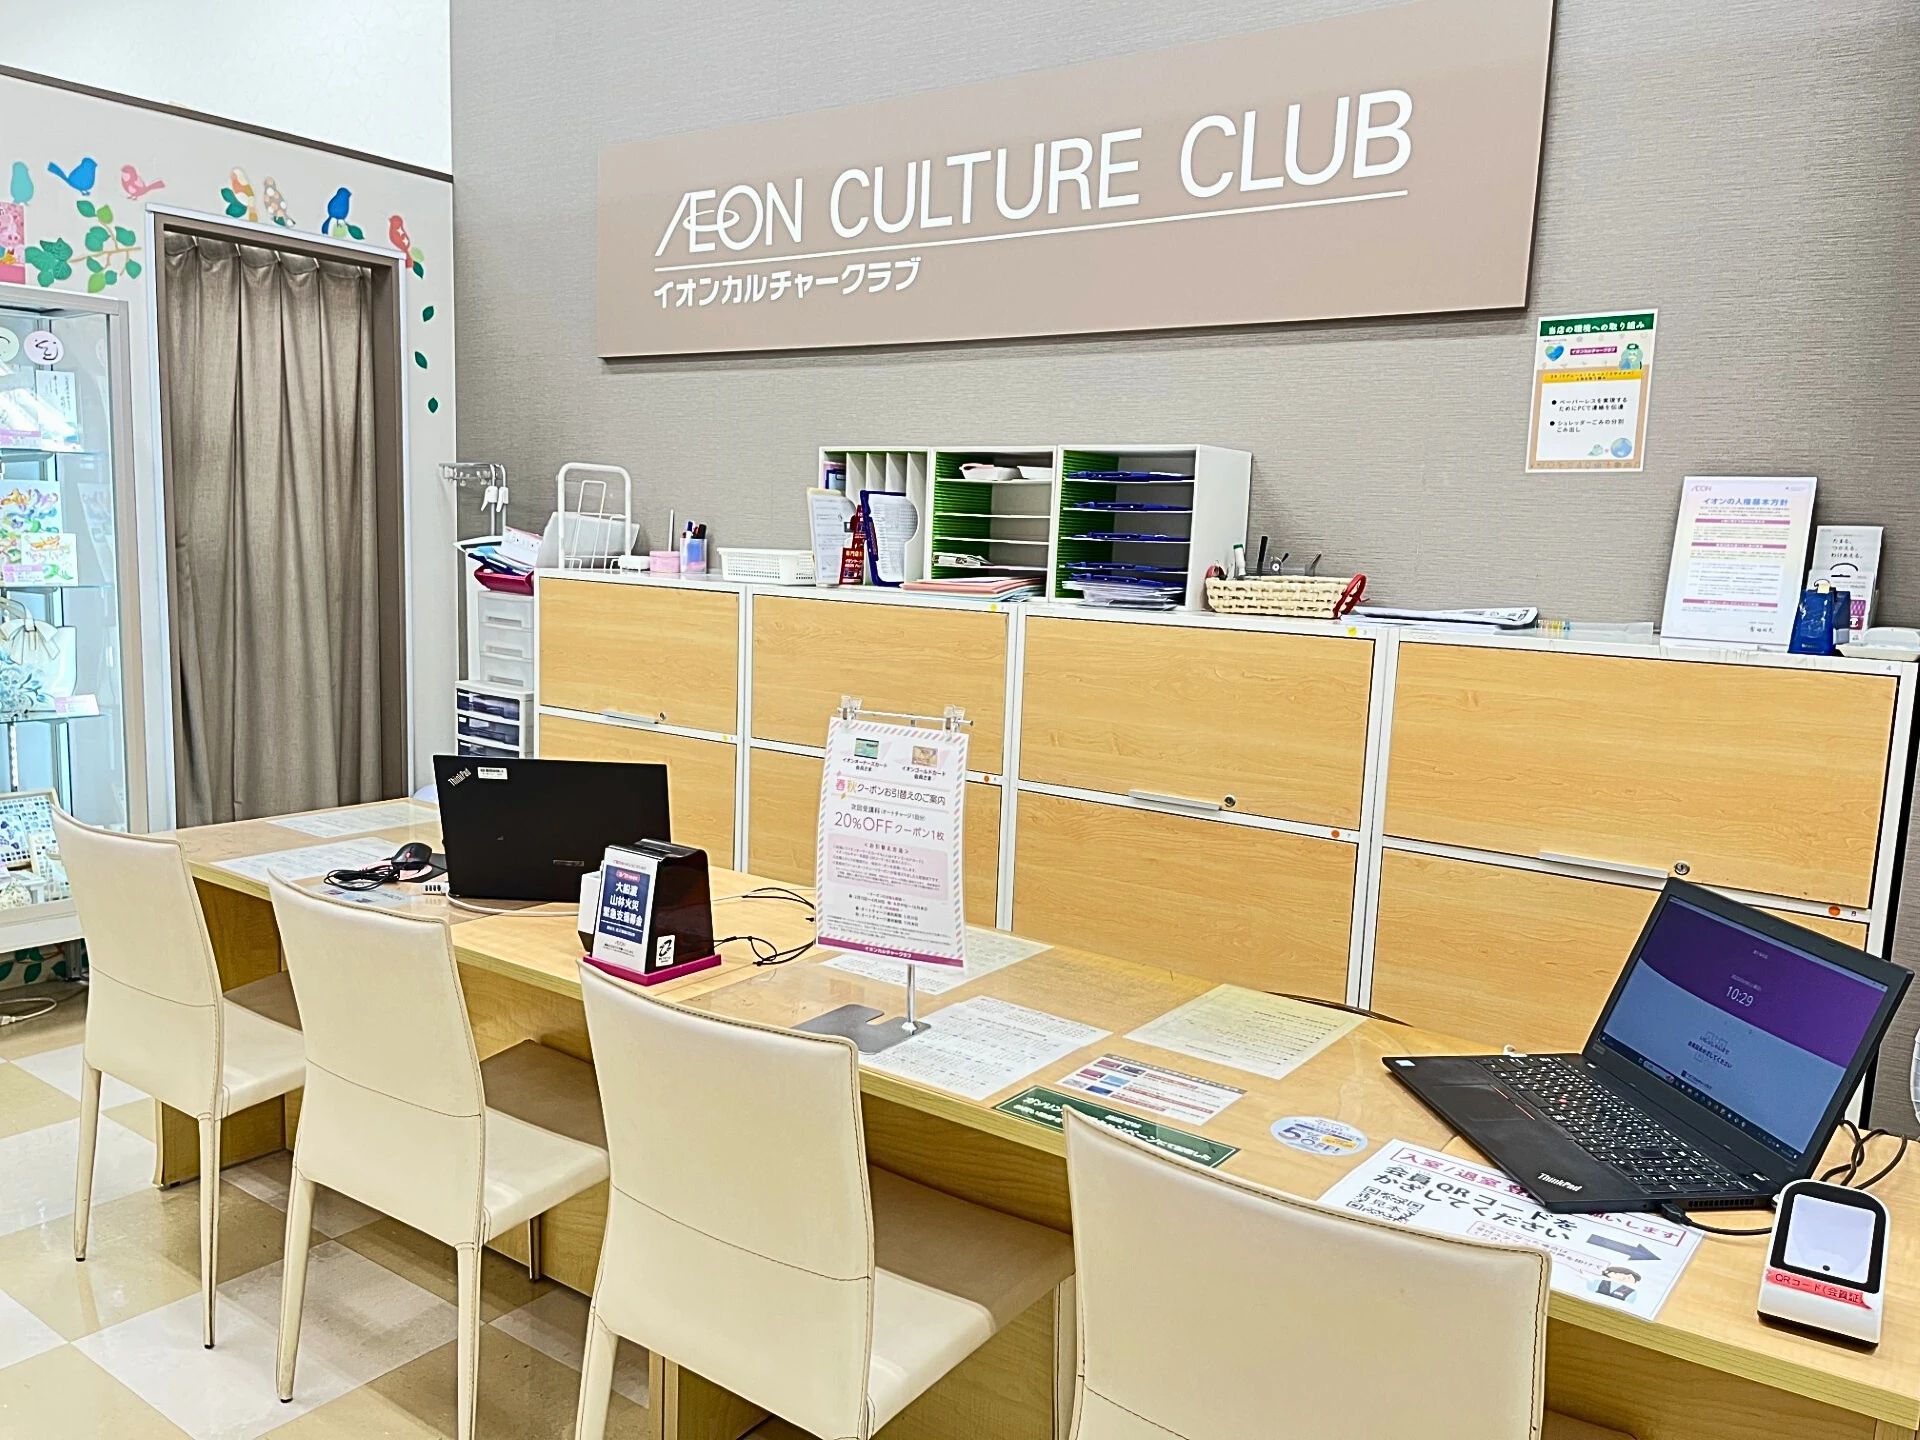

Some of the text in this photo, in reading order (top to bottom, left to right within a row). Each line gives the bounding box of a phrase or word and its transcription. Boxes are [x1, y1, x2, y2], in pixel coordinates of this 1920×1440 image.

[830, 127, 1143, 239] CULTURE
[1180, 88, 1414, 199] CLUB
[653, 256, 923, 309] イオンカルチャークラブ
[447, 767, 472, 787] ThinkPad
[609, 893, 640, 912] 山林火災
[1726, 985, 1754, 1007] 10:29
[1537, 1172, 1584, 1192] ThinkPad
[1373, 1173, 1571, 1241] かざしてください
